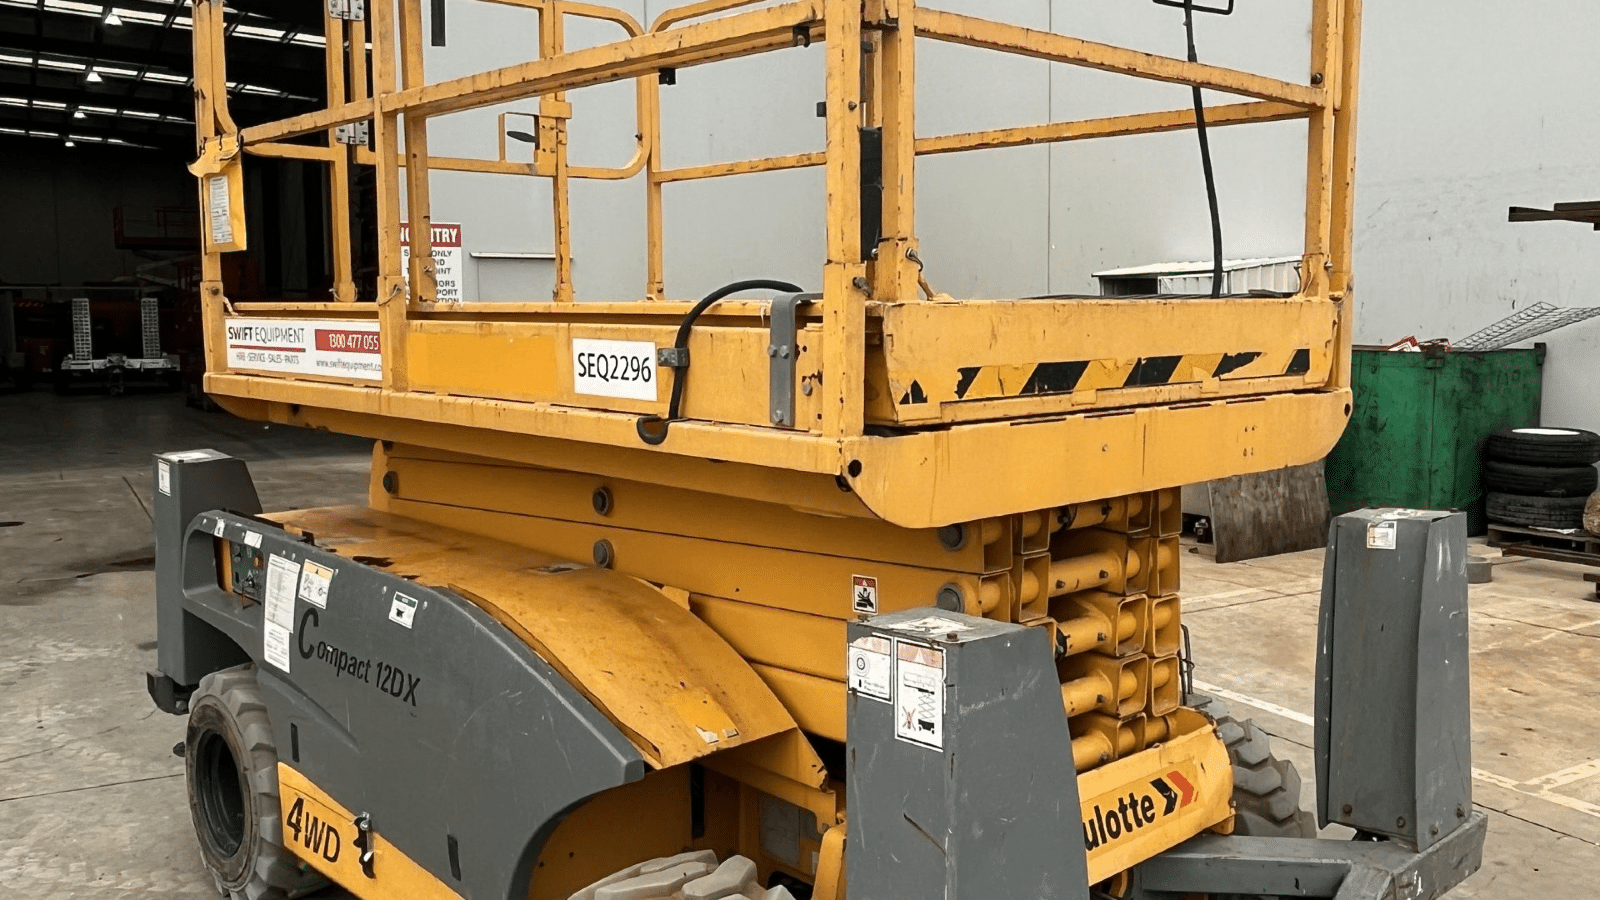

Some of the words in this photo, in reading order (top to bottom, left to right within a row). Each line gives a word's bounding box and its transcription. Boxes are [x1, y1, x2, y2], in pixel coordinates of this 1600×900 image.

[431, 228, 458, 243] TRY
[436, 288, 458, 296] PORT
[228, 326, 253, 341] SWIFT
[255, 327, 305, 344] EQUIPMENT
[329, 333, 346, 348] 1300
[347, 334, 362, 349] 477
[363, 335, 379, 350] 055
[577, 352, 652, 383] SEQ2296
[298, 607, 371, 684] Compact
[375, 660, 421, 707] 12DX
[286, 797, 341, 863] 4WD
[1083, 792, 1155, 852] ulotte
